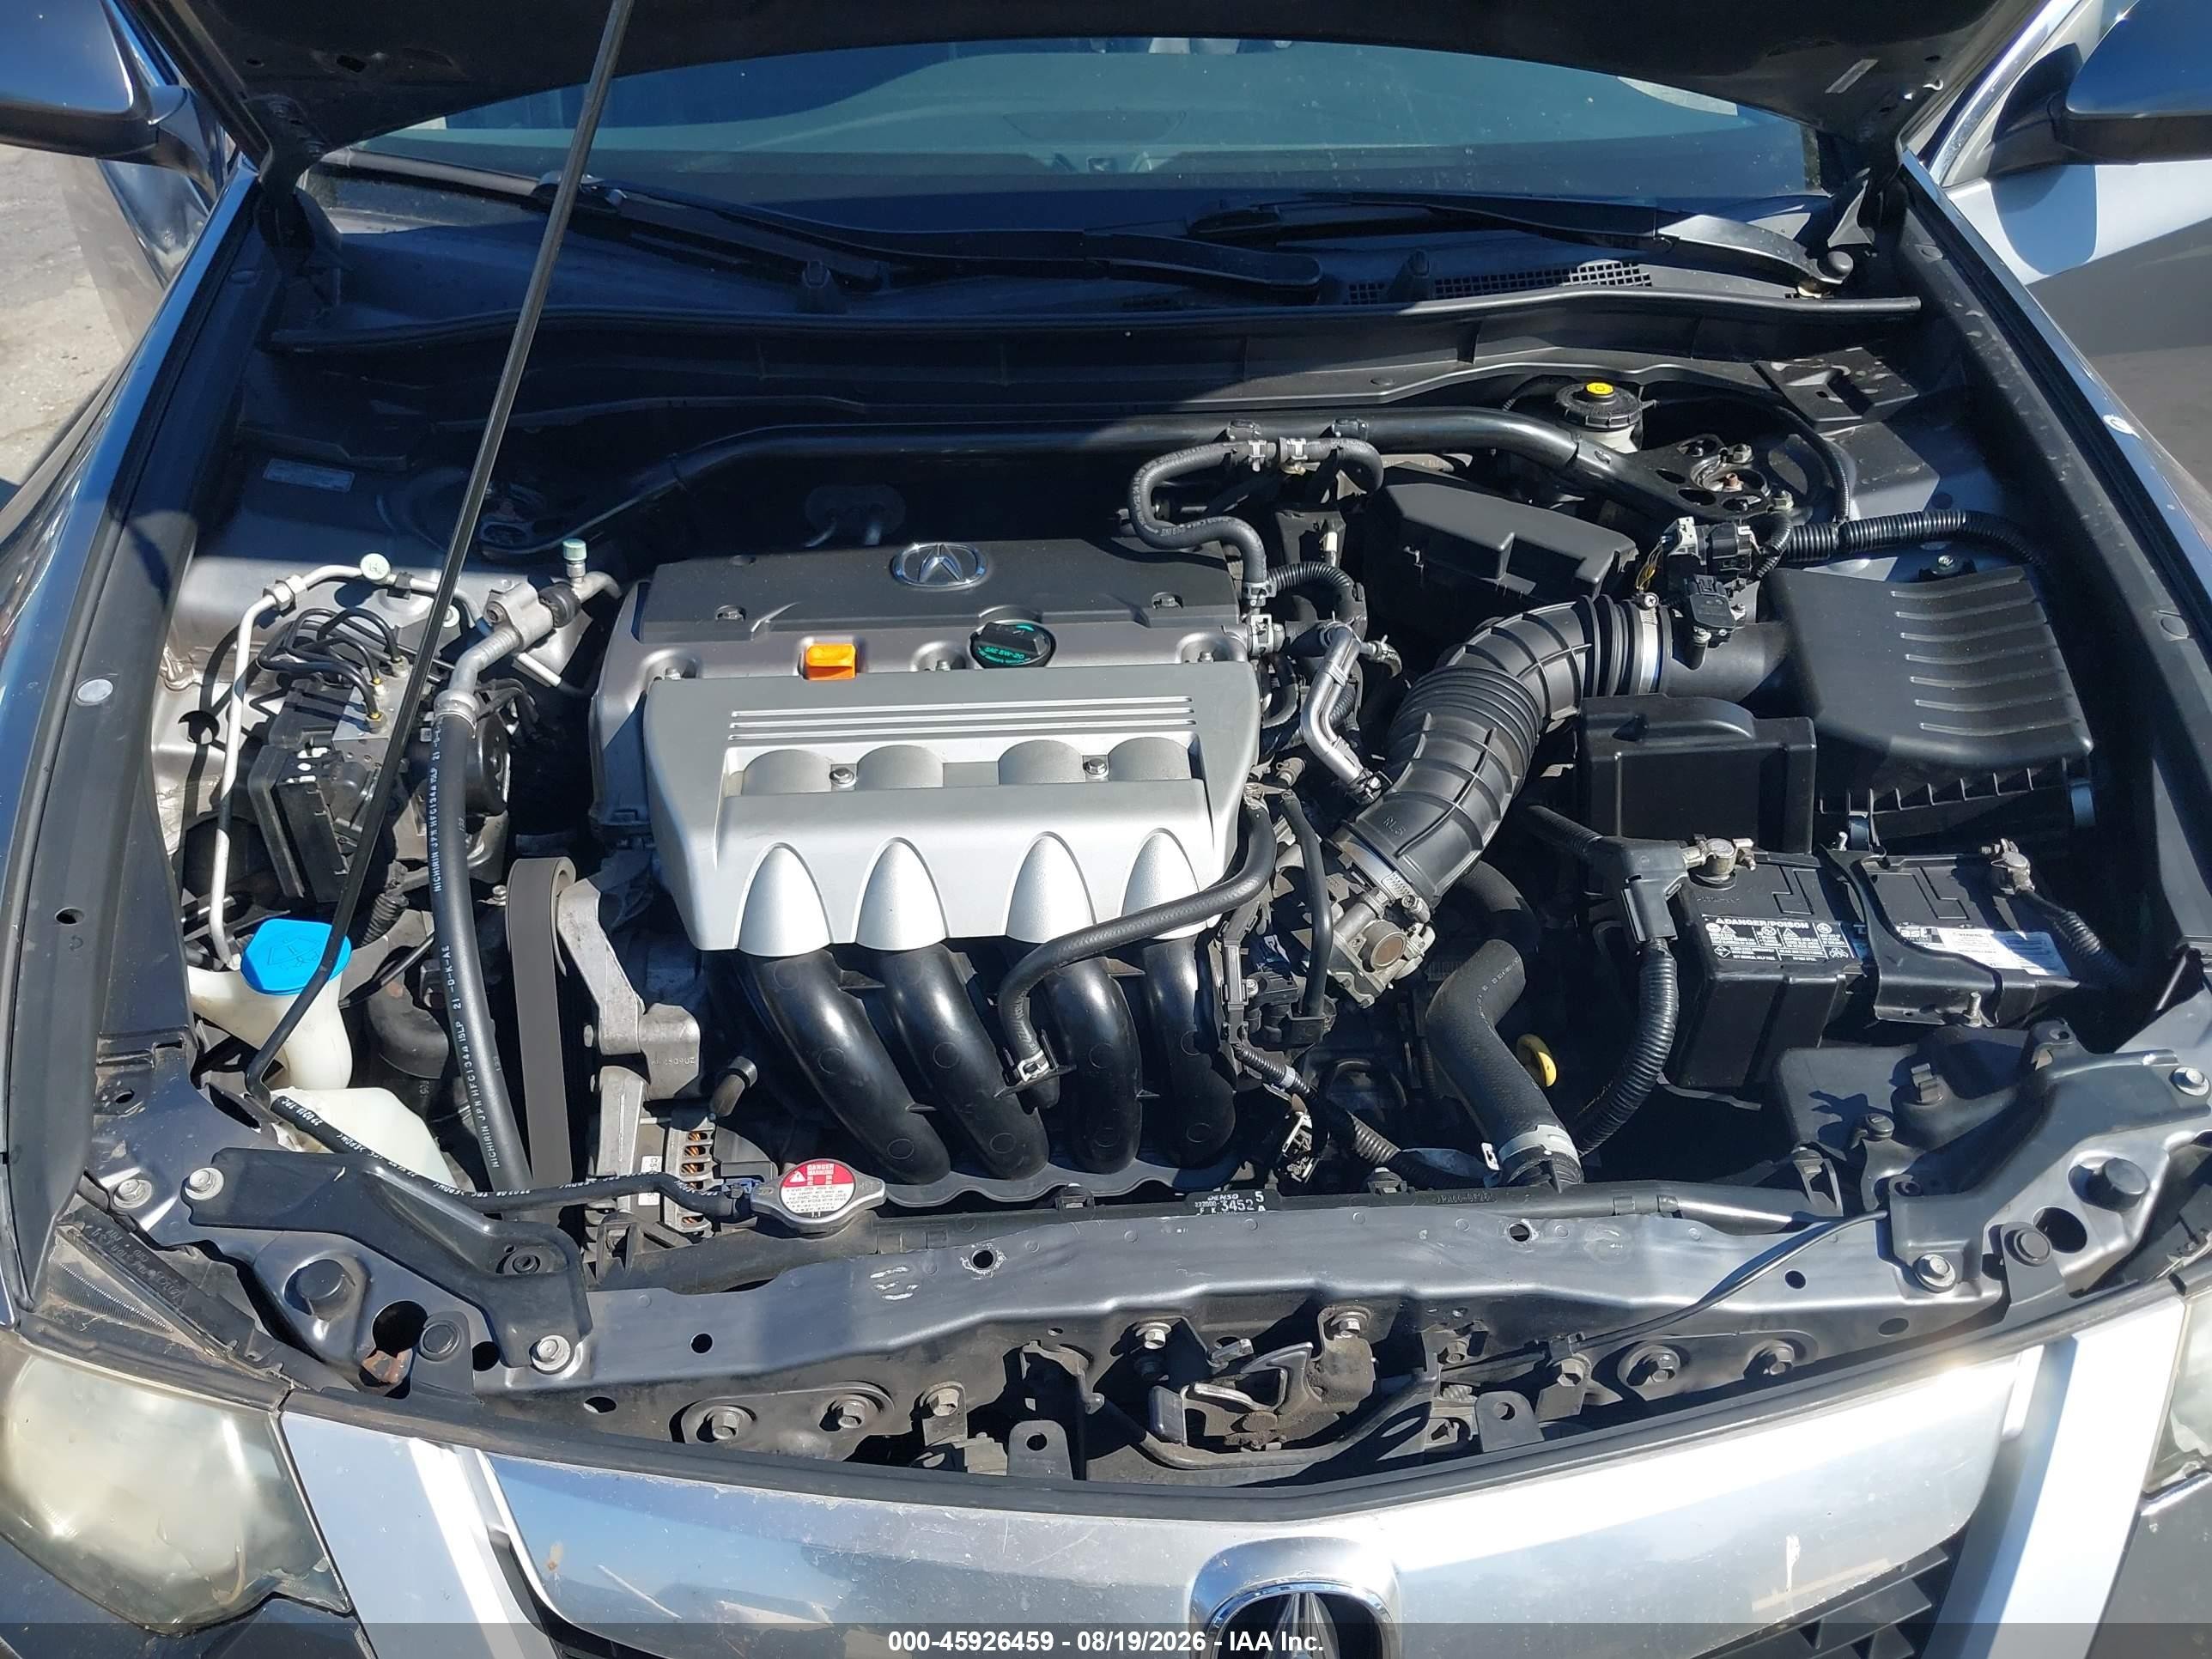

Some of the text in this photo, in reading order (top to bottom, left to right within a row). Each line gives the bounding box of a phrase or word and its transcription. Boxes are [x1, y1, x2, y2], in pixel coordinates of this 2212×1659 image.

[474, 1100, 487, 1121] JPN
[480, 1125, 500, 1168] NICHIRIN
[1206, 1193, 1239, 1201] DENSO
[1255, 1190, 1265, 1202] 5
